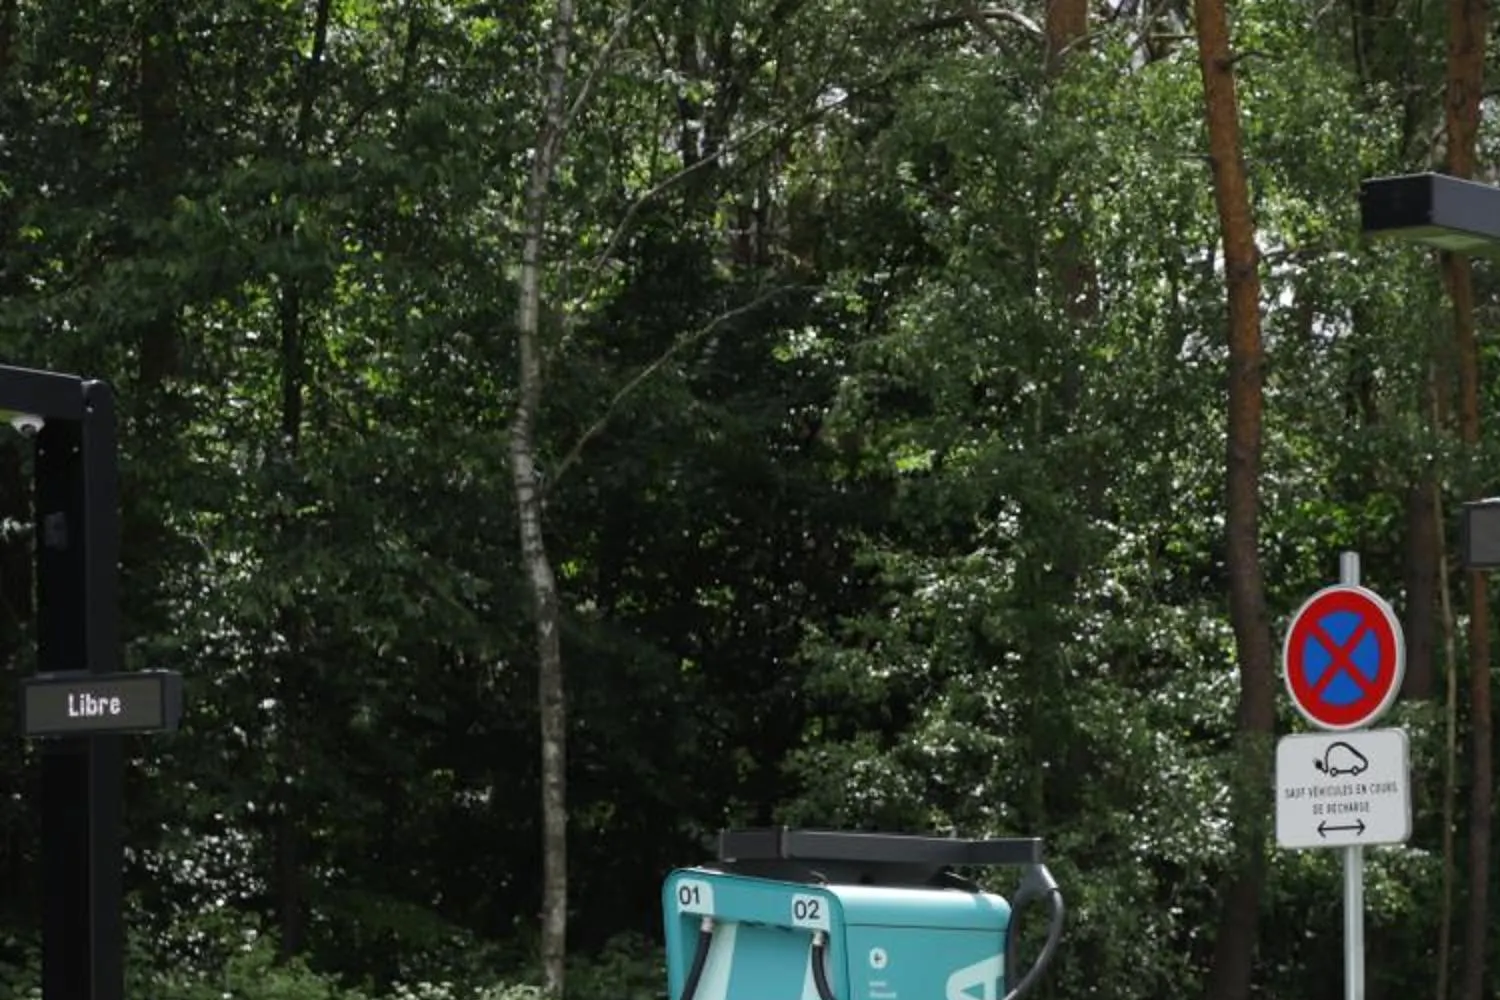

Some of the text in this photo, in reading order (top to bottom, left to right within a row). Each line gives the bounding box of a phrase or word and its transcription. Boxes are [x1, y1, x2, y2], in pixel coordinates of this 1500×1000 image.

[68, 693, 121, 717] Libre
[679, 886, 700, 905] 01
[794, 900, 821, 920] 02
